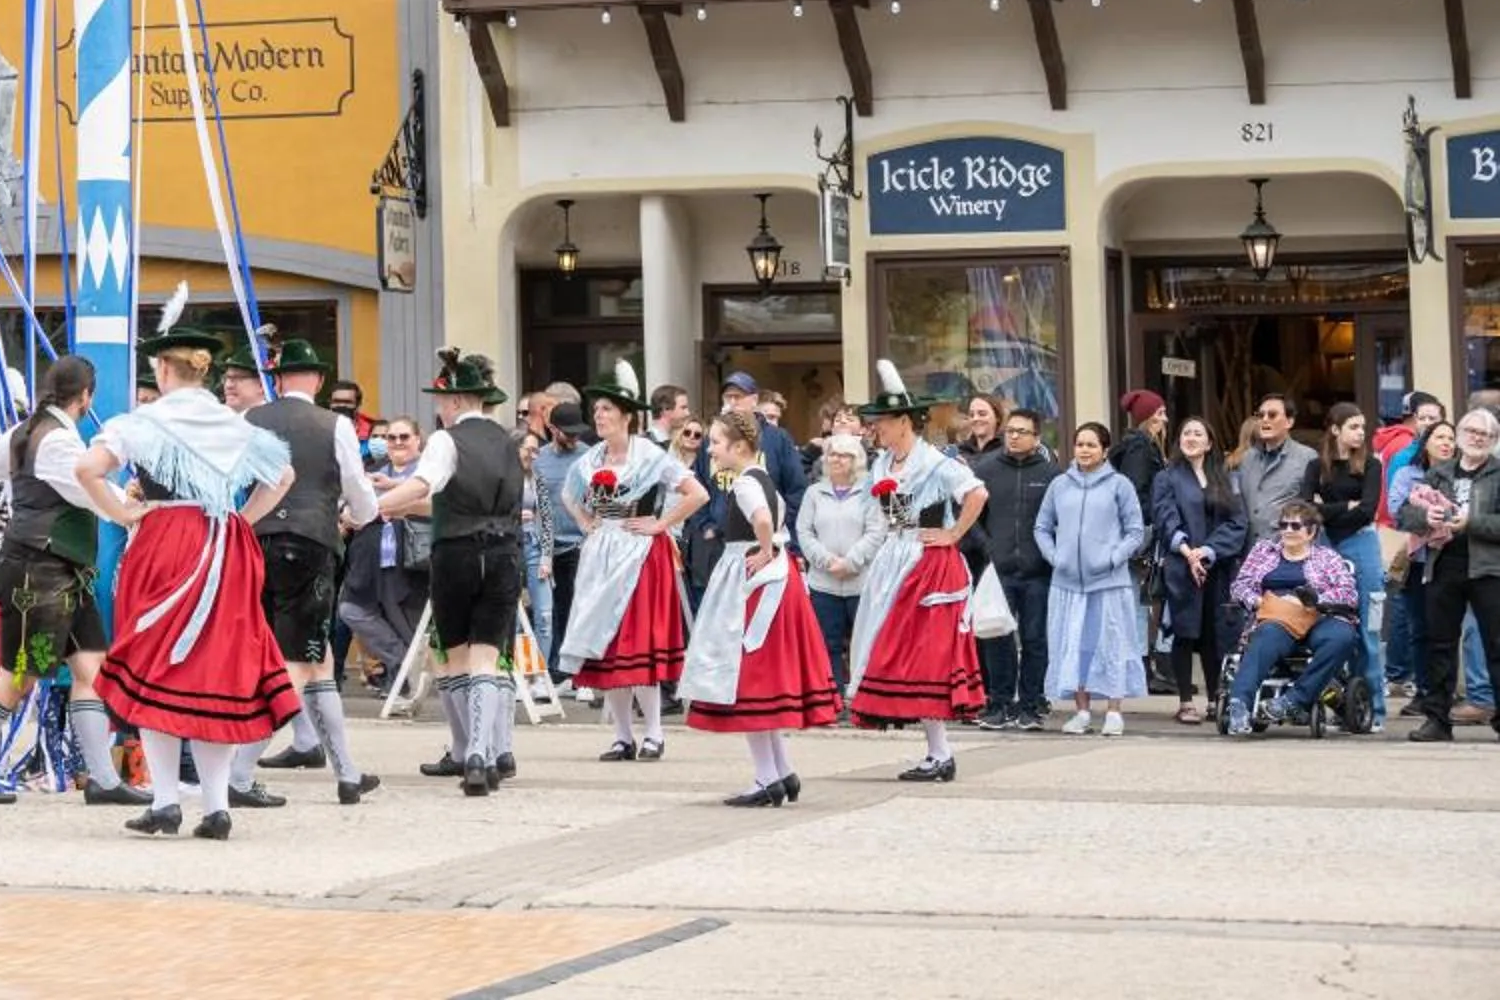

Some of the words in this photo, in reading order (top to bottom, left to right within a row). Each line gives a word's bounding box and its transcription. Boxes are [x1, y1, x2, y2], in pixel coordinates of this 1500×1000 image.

[211, 37, 325, 73] Modern
[150, 81, 221, 110] Suply
[231, 79, 268, 103] Co.
[1241, 122, 1274, 142] 821
[879, 157, 956, 194] Icicle
[962, 155, 1053, 197] Ridge
[1470, 146, 1500, 182] B
[928, 195, 1008, 221] Winery
